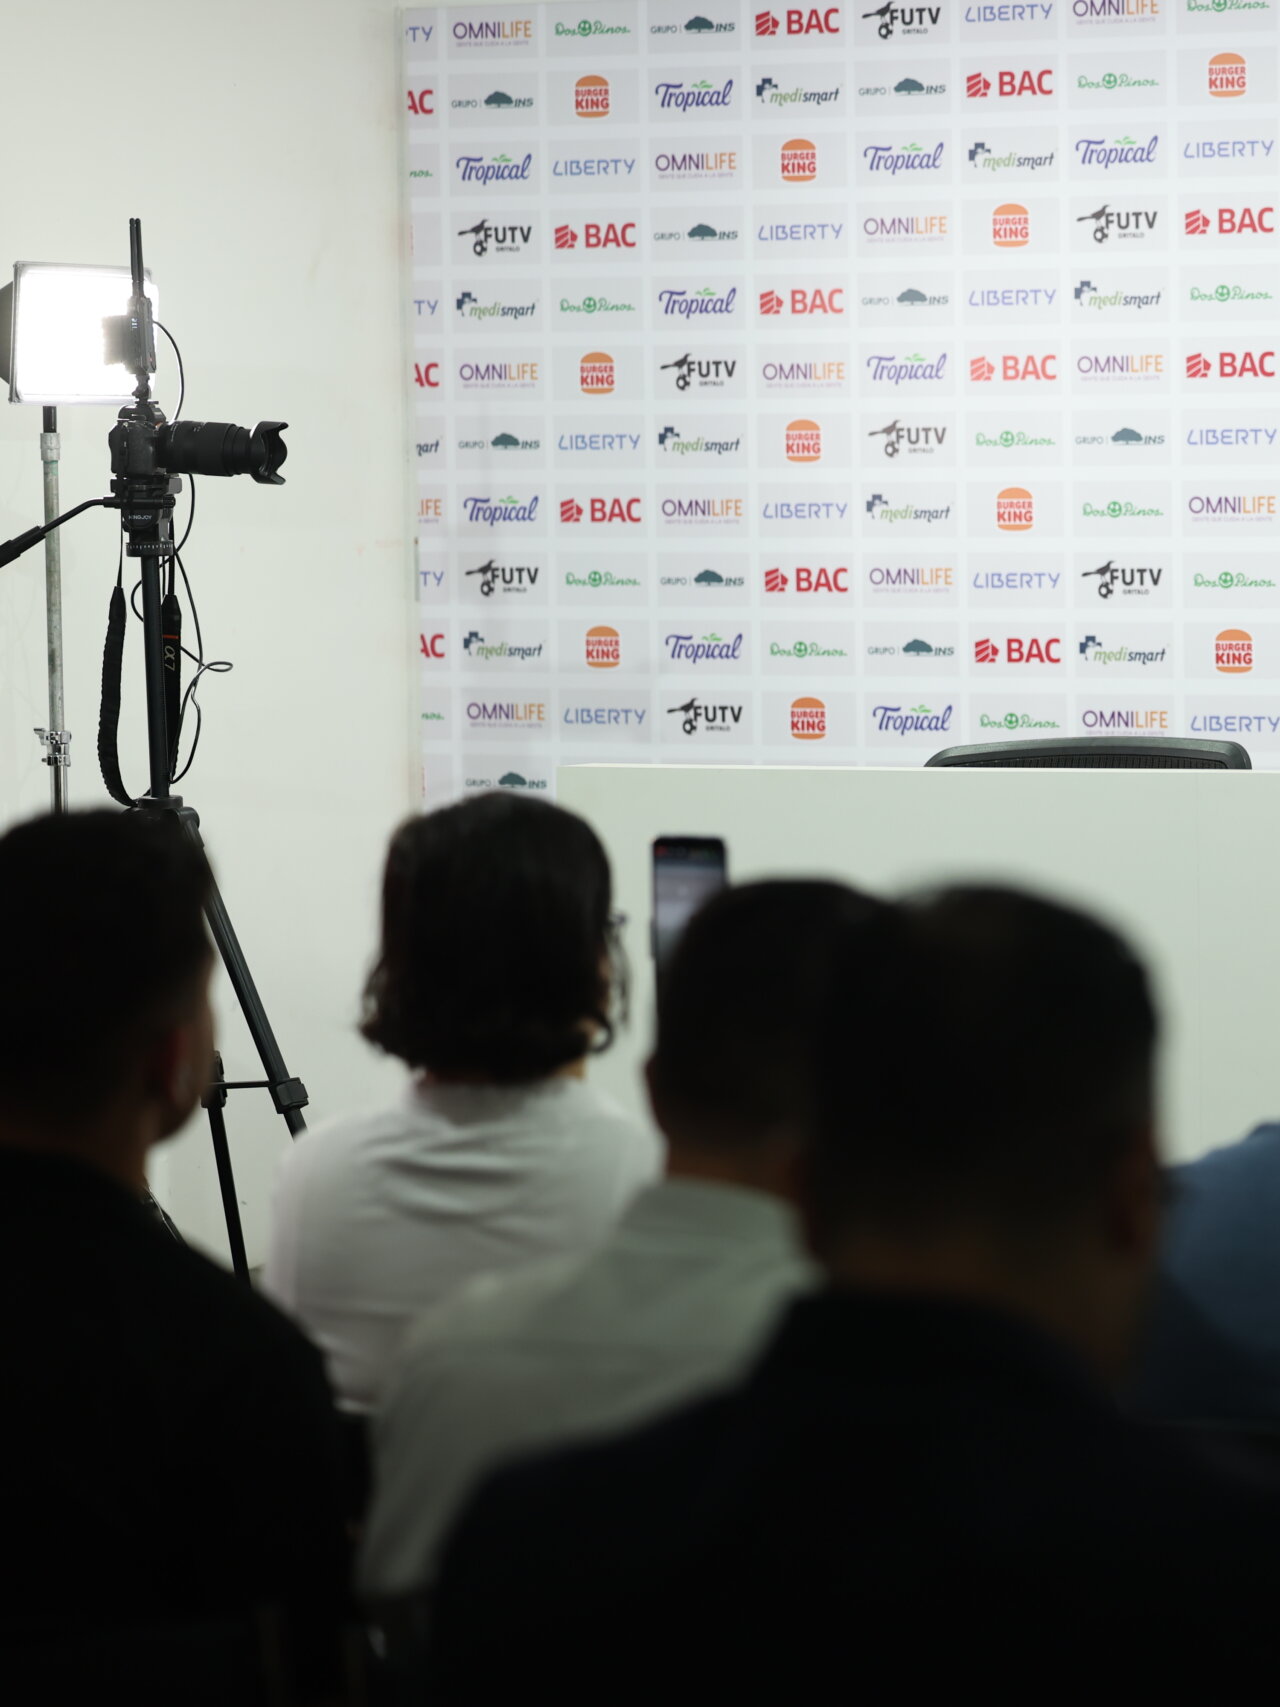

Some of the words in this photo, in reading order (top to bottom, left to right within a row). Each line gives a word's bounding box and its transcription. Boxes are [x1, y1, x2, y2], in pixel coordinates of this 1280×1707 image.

[1209, 64, 1246, 75] BURGER
[999, 69, 1053, 96] BAC
[1209, 77, 1246, 91] KING
[451, 100, 477, 108] GRUPO
[512, 98, 533, 108] INS
[781, 150, 816, 161] BURGER
[1075, 135, 1158, 169] Tropical
[1184, 140, 1274, 158] LIBERTY
[456, 153, 532, 185] Tropical
[655, 153, 736, 171] OMNILIFE
[781, 160, 816, 176] KING
[483, 227, 531, 244] FUTV
[585, 223, 636, 248] BAC
[758, 224, 842, 241] LIBERTY
[862, 297, 889, 306] GRUPO
[927, 296, 948, 305] INS
[1089, 291, 1161, 309] medismart
[1190, 287, 1216, 301] Dos
[1228, 286, 1273, 300] Pinos
[470, 303, 535, 320] medismart
[560, 299, 583, 312] Dos
[763, 362, 844, 381] OMNILIFE
[867, 353, 947, 385] Tropical
[1003, 355, 1056, 380] BAC
[1187, 429, 1277, 445] LIBERTY
[590, 498, 641, 522] BAC
[763, 503, 847, 519] LIBERTY
[1083, 503, 1107, 517] Dos
[1120, 502, 1163, 516] Pinos
[1189, 496, 1276, 514] OMNILIFE
[880, 505, 950, 523] medismart
[490, 568, 538, 586] FUTV
[660, 577, 687, 585] GRUPO
[723, 578, 744, 586] INS
[869, 568, 953, 585] OMNILIFE
[1110, 568, 1162, 586] FUTV
[586, 648, 619, 659] KING
[665, 633, 743, 664] Tropical
[770, 642, 794, 656] Dos
[1007, 638, 1060, 663] BAC
[1216, 643, 1252, 651] BURGER
[1094, 647, 1166, 665] medismart
[1216, 653, 1252, 664] KING
[980, 714, 1004, 728] Dos
[1018, 714, 1060, 728] Pinos
[1082, 710, 1168, 728] OMNILIFE
[1191, 716, 1280, 732] LIBERTY
